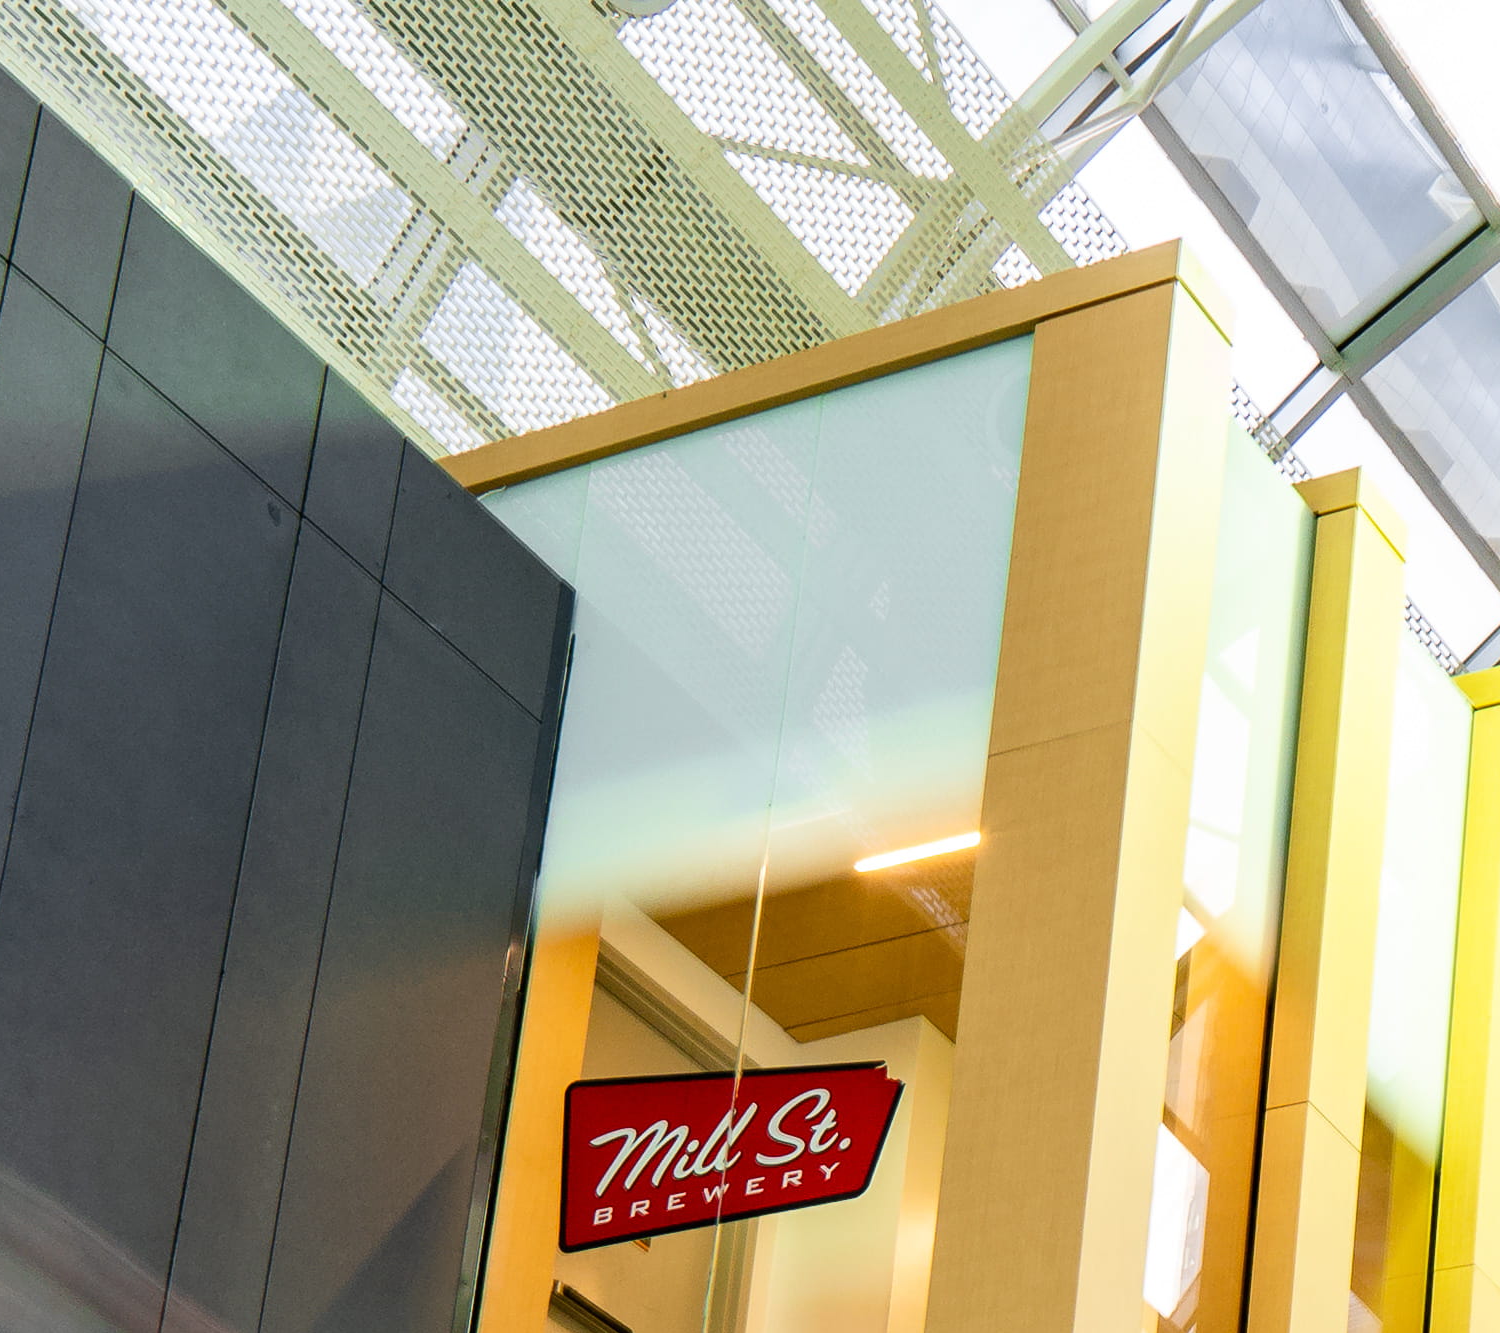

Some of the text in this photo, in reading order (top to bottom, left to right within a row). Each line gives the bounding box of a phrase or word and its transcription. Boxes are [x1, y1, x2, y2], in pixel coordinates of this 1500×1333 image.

[589, 1088, 852, 1198] Mill St.
[592, 1161, 841, 1226] BREWERY
